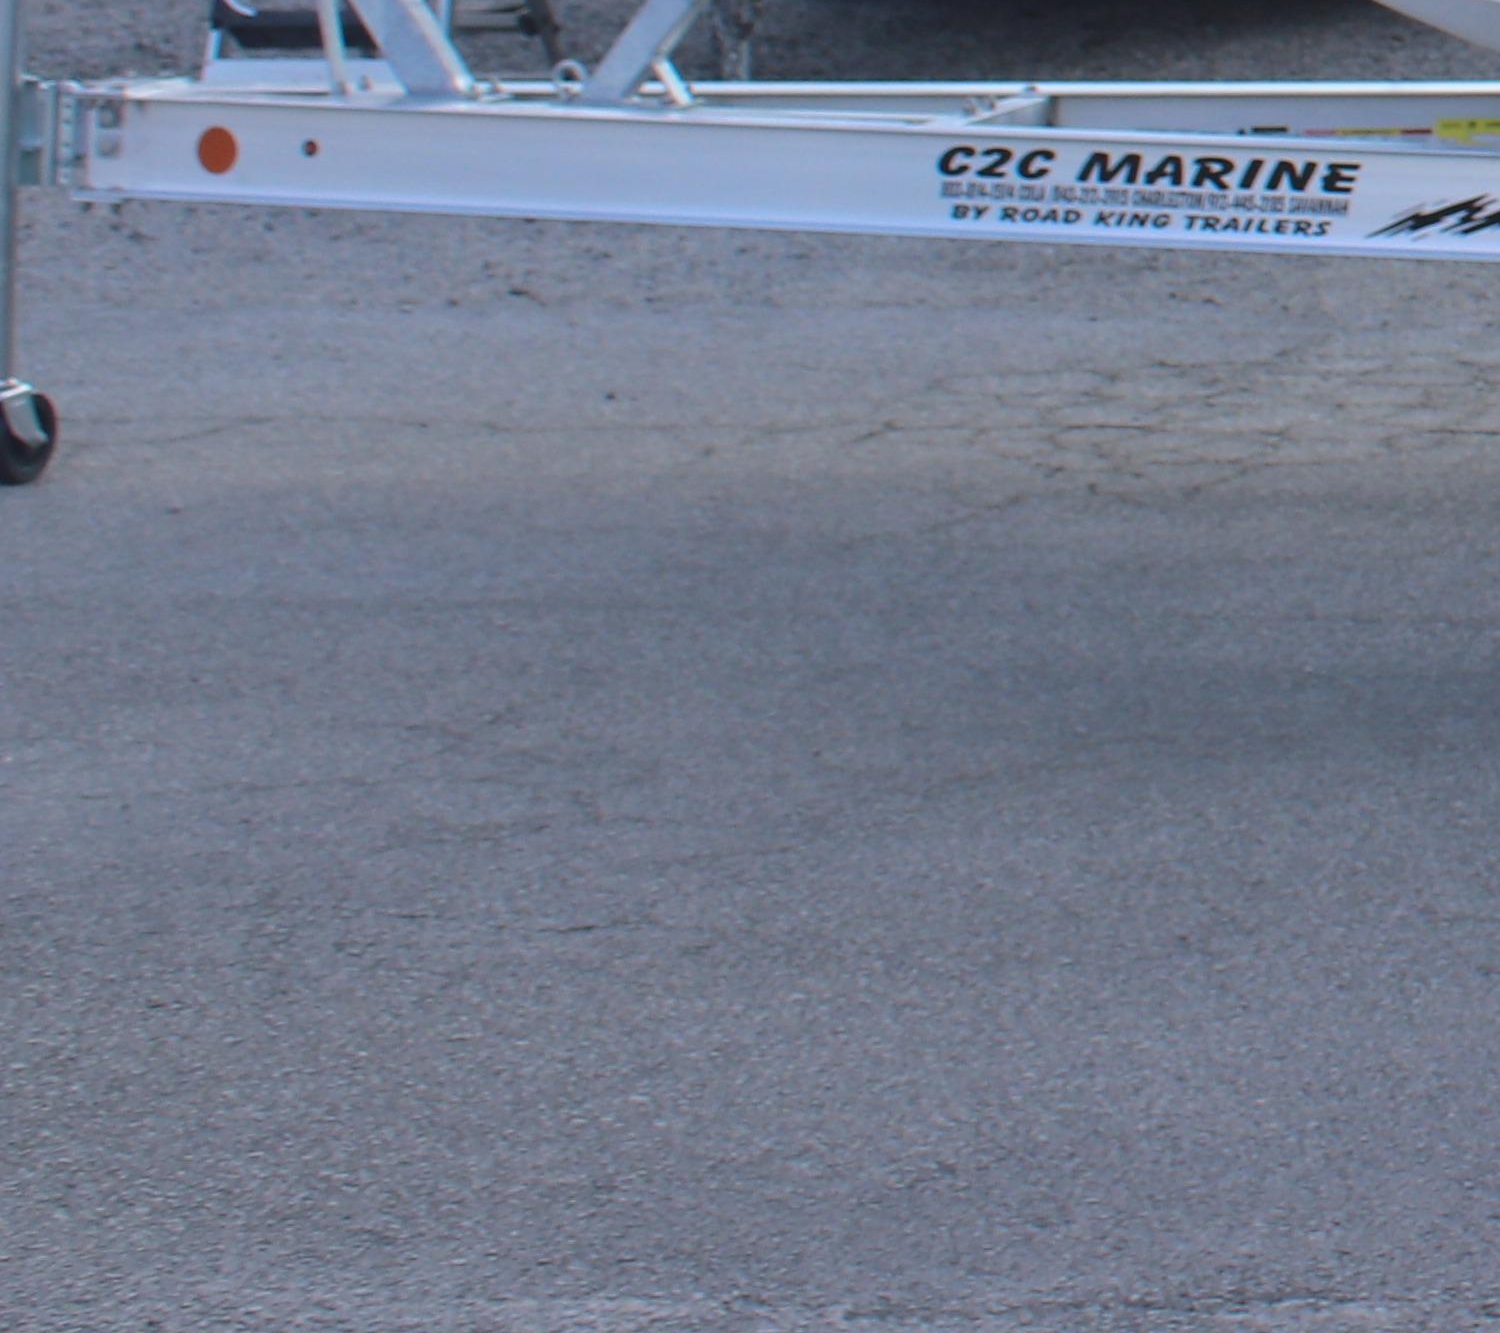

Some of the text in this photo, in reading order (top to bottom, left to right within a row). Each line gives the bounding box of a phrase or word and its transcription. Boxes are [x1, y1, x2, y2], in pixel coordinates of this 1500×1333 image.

[938, 145, 1362, 194] C2C MARINE
[950, 203, 1331, 237] BY ROAD KING TRAILERS
